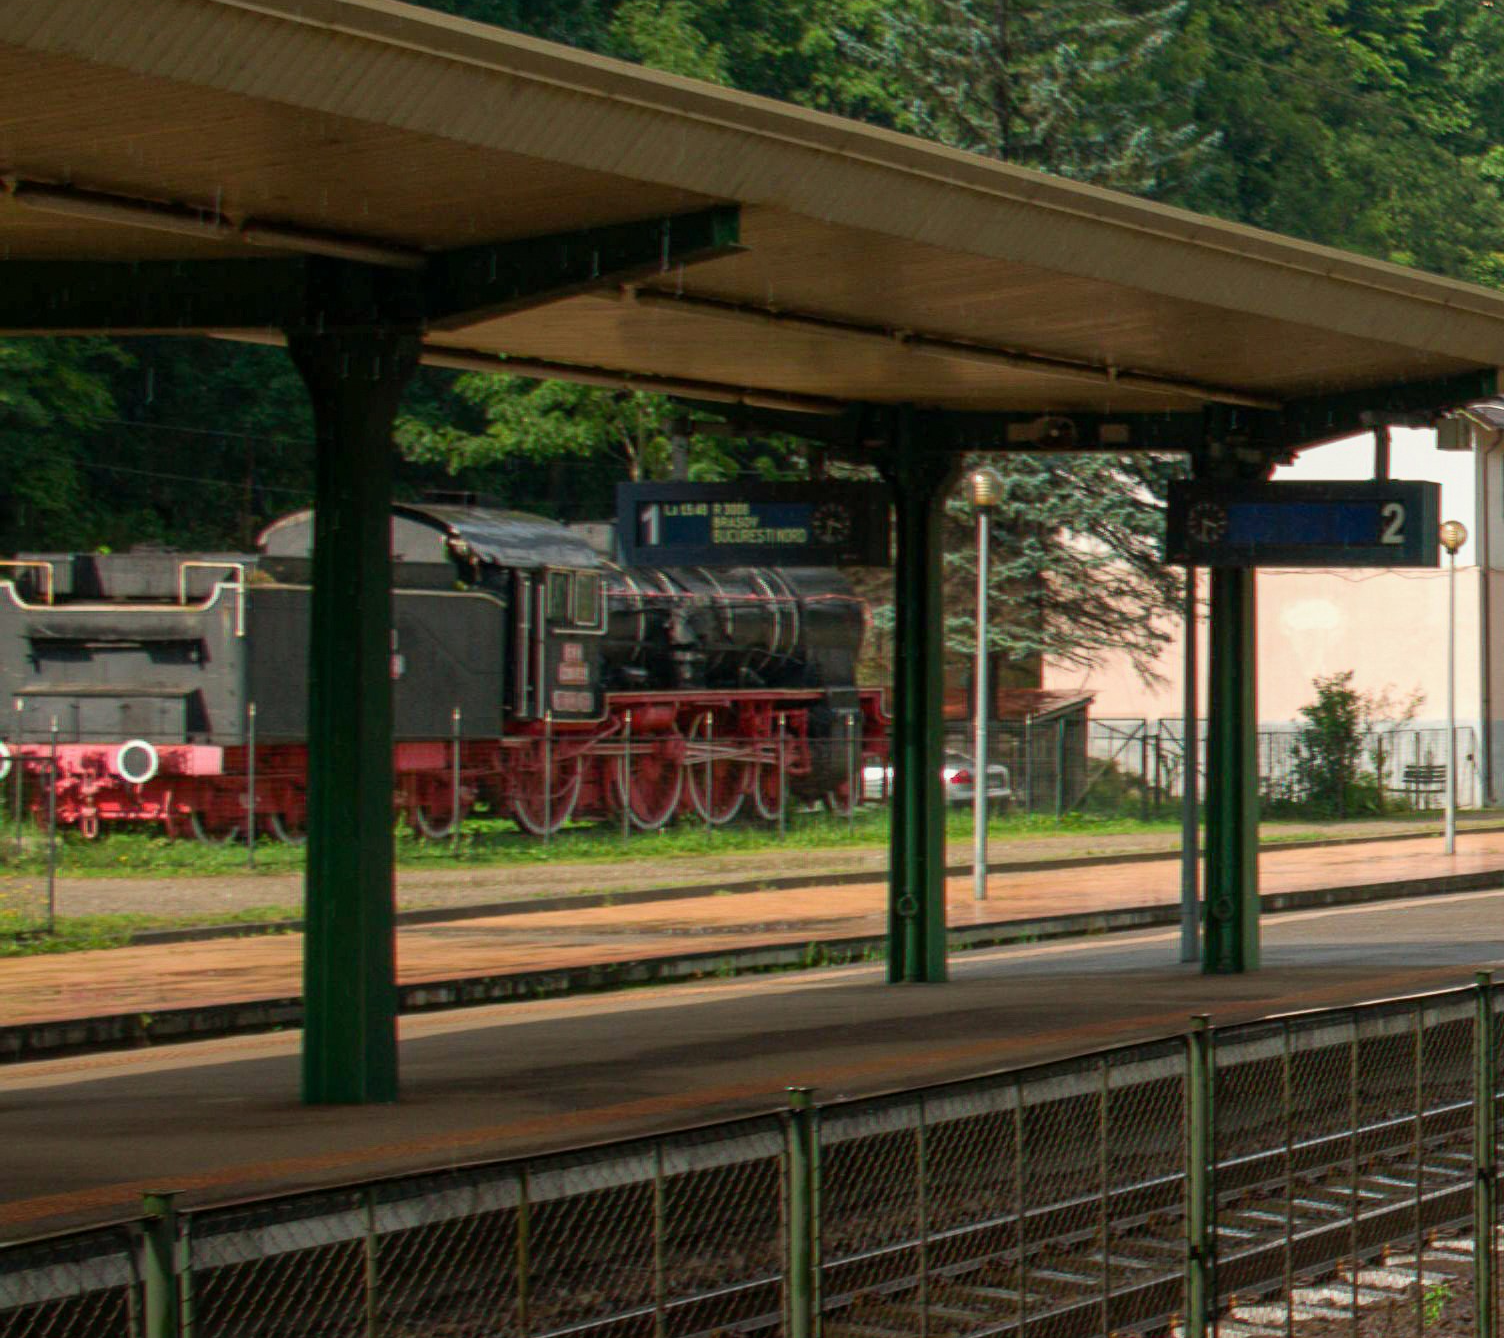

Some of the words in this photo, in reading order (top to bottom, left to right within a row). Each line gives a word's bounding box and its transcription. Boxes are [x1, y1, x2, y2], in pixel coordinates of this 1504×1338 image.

[641, 504, 660, 545] 1
[776, 528, 808, 543] NORD
[1381, 503, 1407, 544] 2
